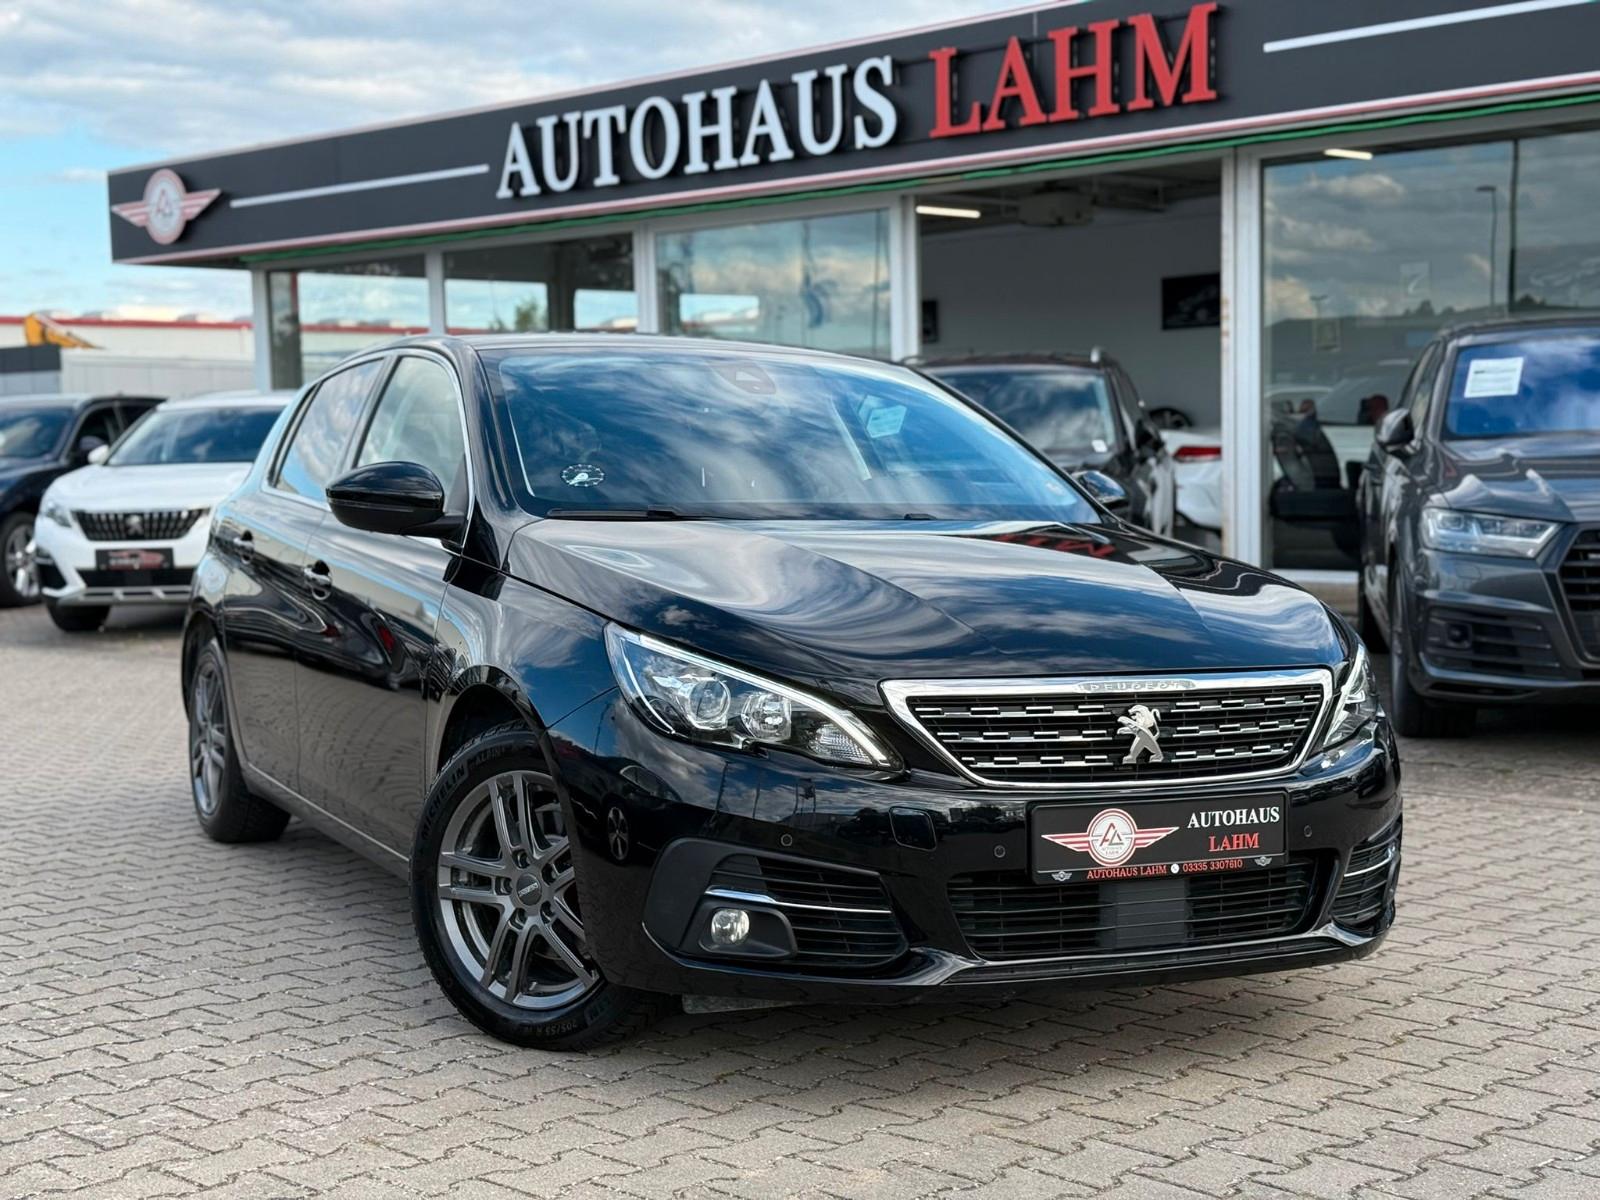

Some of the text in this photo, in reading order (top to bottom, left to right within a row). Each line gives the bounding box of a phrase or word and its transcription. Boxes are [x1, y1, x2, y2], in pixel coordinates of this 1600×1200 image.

[496, 2, 1218, 198] AUTOHAUS LAHM
[1089, 681, 1181, 692] PEUGEOT
[420, 765, 466, 840] MICHELIN
[1187, 806, 1281, 829] AUTOHAUS
[1208, 832, 1260, 852] LAHM
[1087, 859, 1243, 880] AUTOHAUS LAHM 03335 3307610
